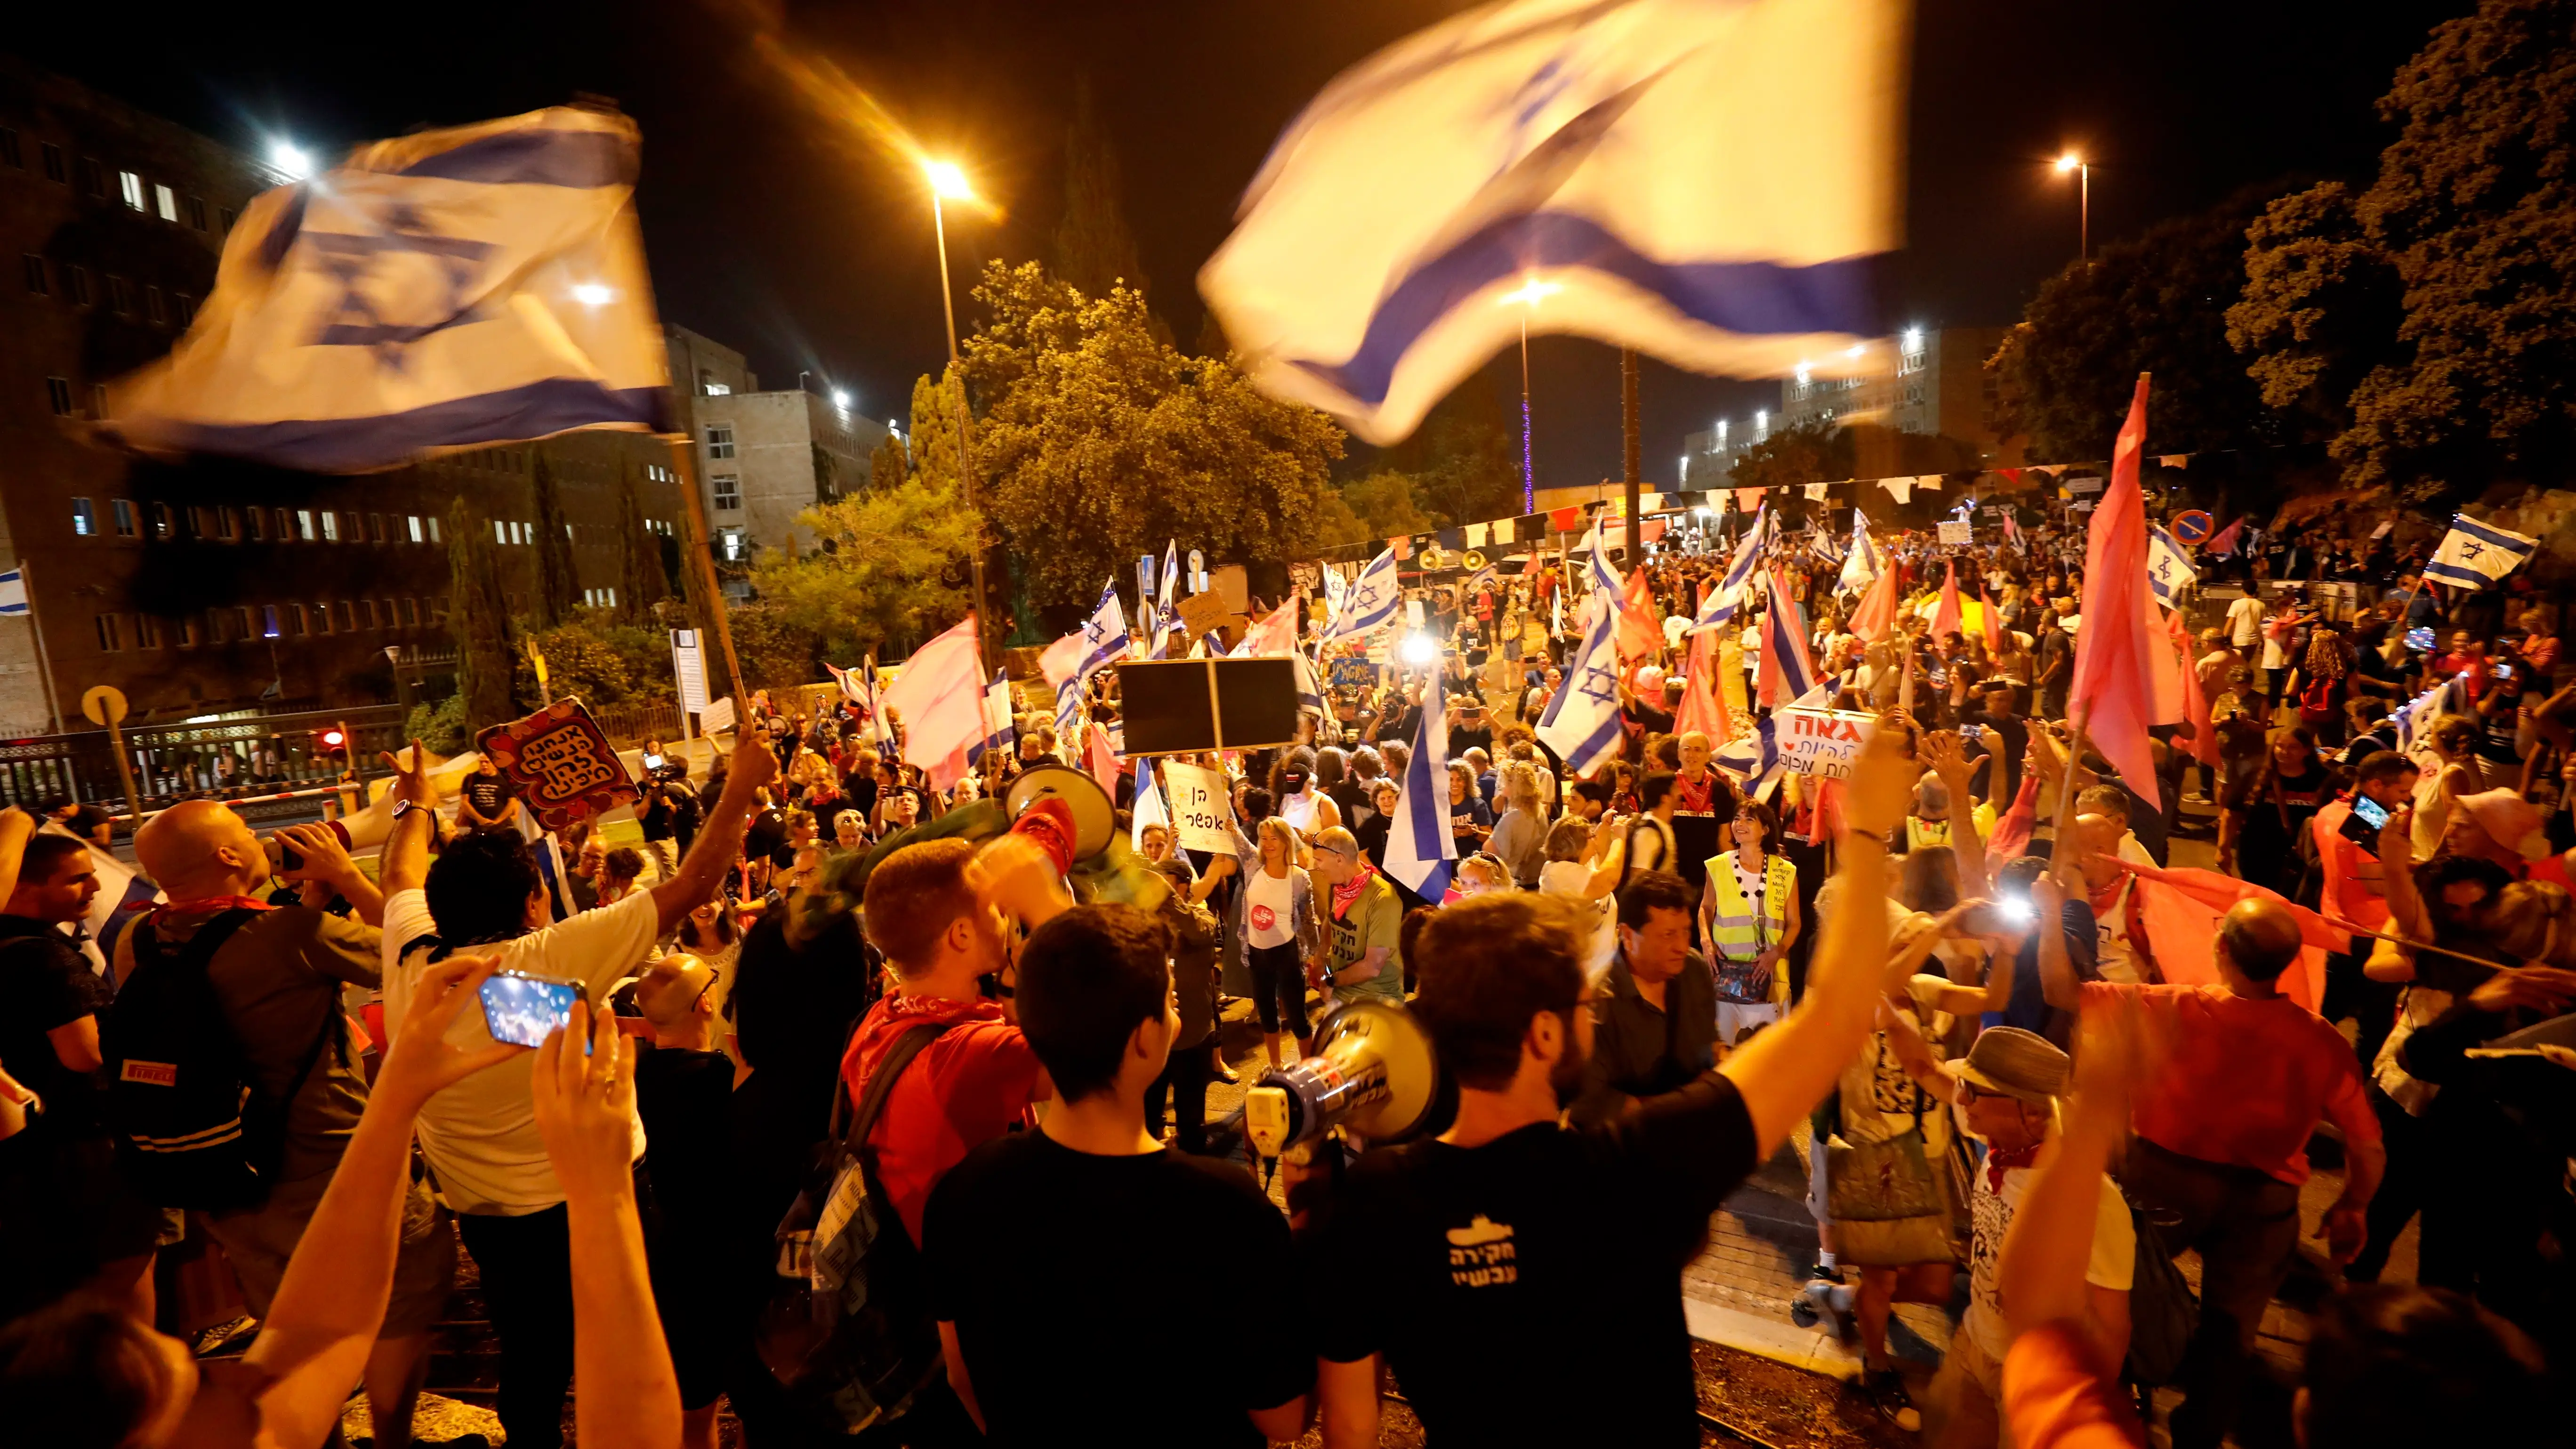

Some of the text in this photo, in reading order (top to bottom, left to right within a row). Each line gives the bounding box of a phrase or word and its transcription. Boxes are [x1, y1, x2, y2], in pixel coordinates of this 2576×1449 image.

[1794, 715, 1863, 743] גאה
[527, 726, 582, 756] אנחנו
[1797, 740, 1855, 760] להיות
[526, 740, 590, 772] הנשים
[547, 755, 591, 785] להן
[1823, 763, 1852, 779] חת
[550, 766, 611, 796] חיכינו
[1192, 786, 1207, 806] הן
[1185, 812, 1223, 830] אפשר
[1332, 927, 1355, 946] חקיר
[1332, 944, 1354, 961] עכש
[128, 1064, 175, 1082] PIREL
[1449, 1242, 1516, 1266] חקירה
[1452, 1265, 1518, 1288] עכשיו
